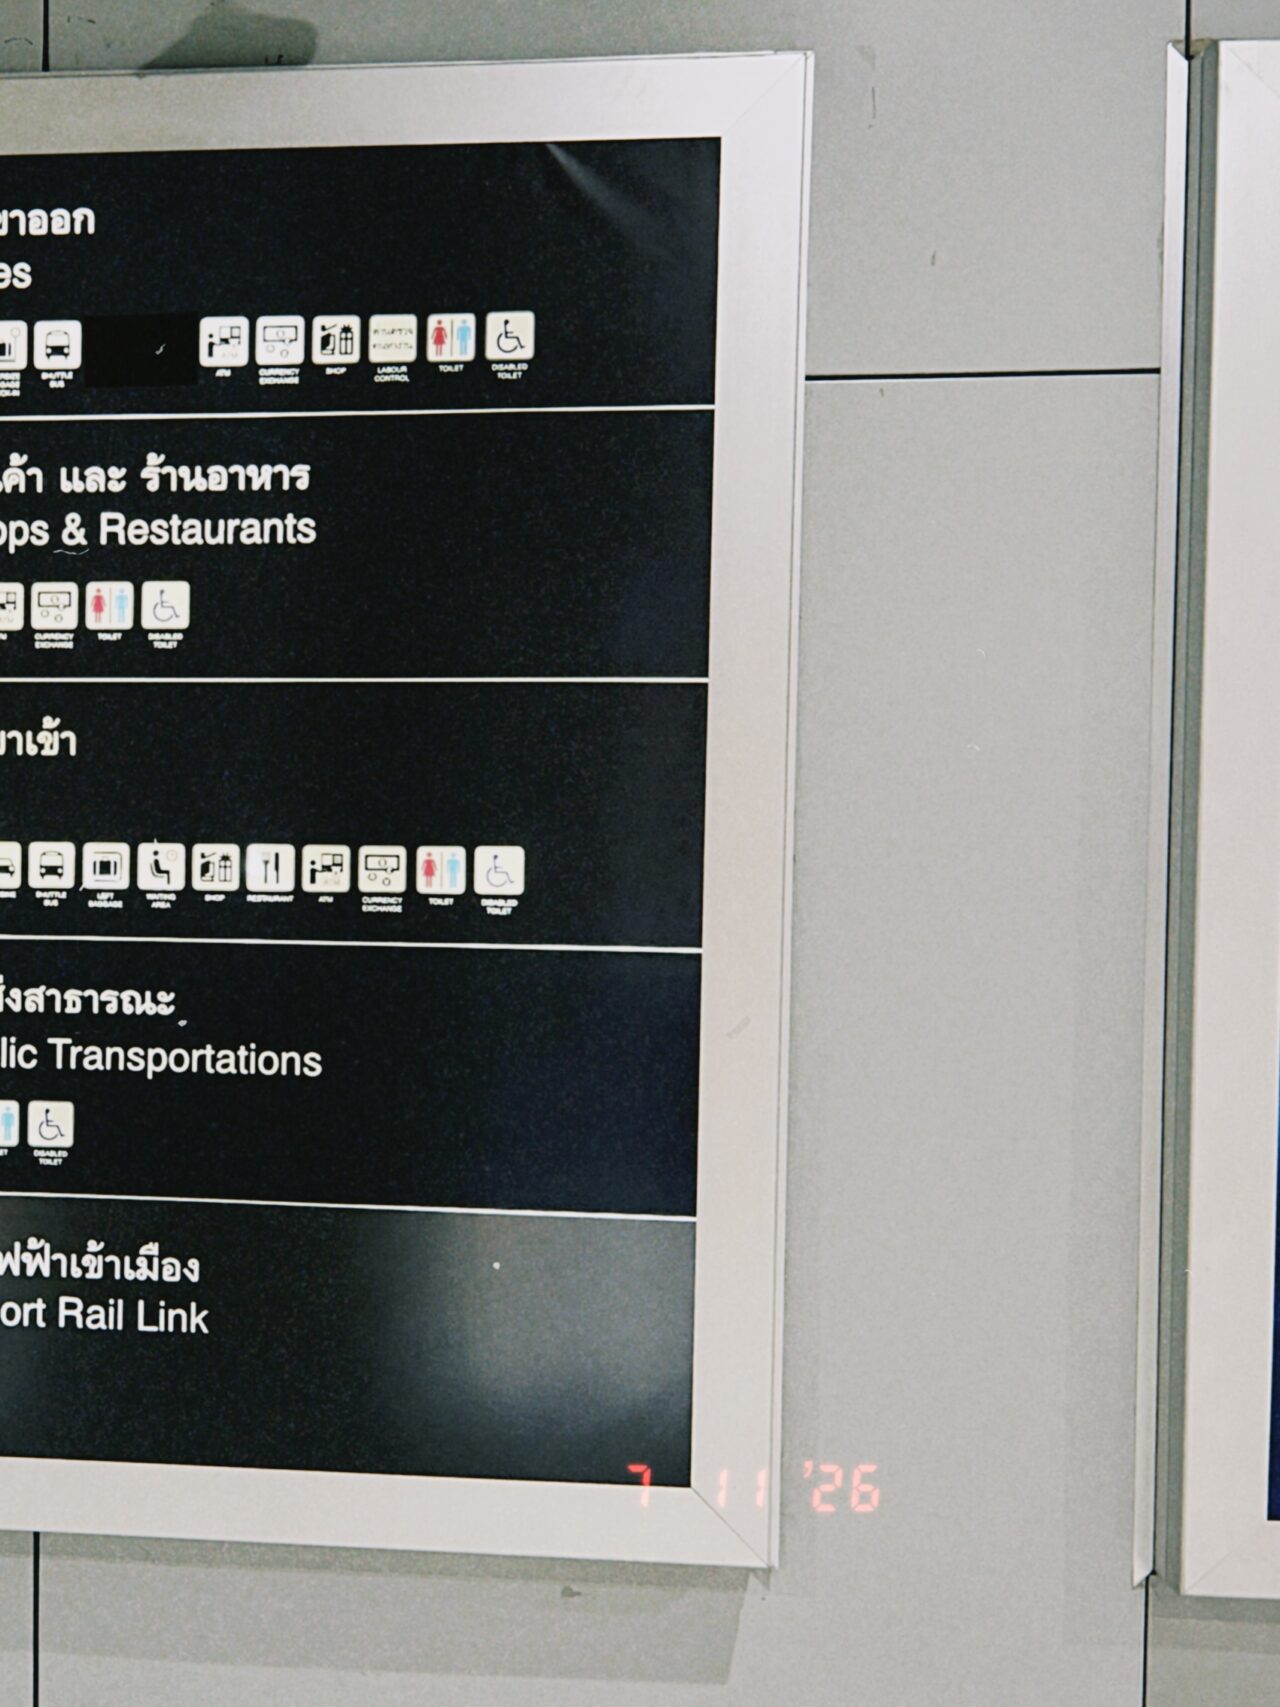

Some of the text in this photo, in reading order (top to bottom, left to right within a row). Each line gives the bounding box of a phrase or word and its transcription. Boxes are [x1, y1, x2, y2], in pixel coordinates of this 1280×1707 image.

[60, 466, 126, 493] และ
[140, 452, 310, 492] ร้านอาหาร
[62, 512, 87, 545] &
[100, 512, 316, 545] Restaurants
[47, 1038, 322, 1079] Transportations
[59, 1298, 123, 1330] Rail
[138, 1300, 208, 1333] Link
